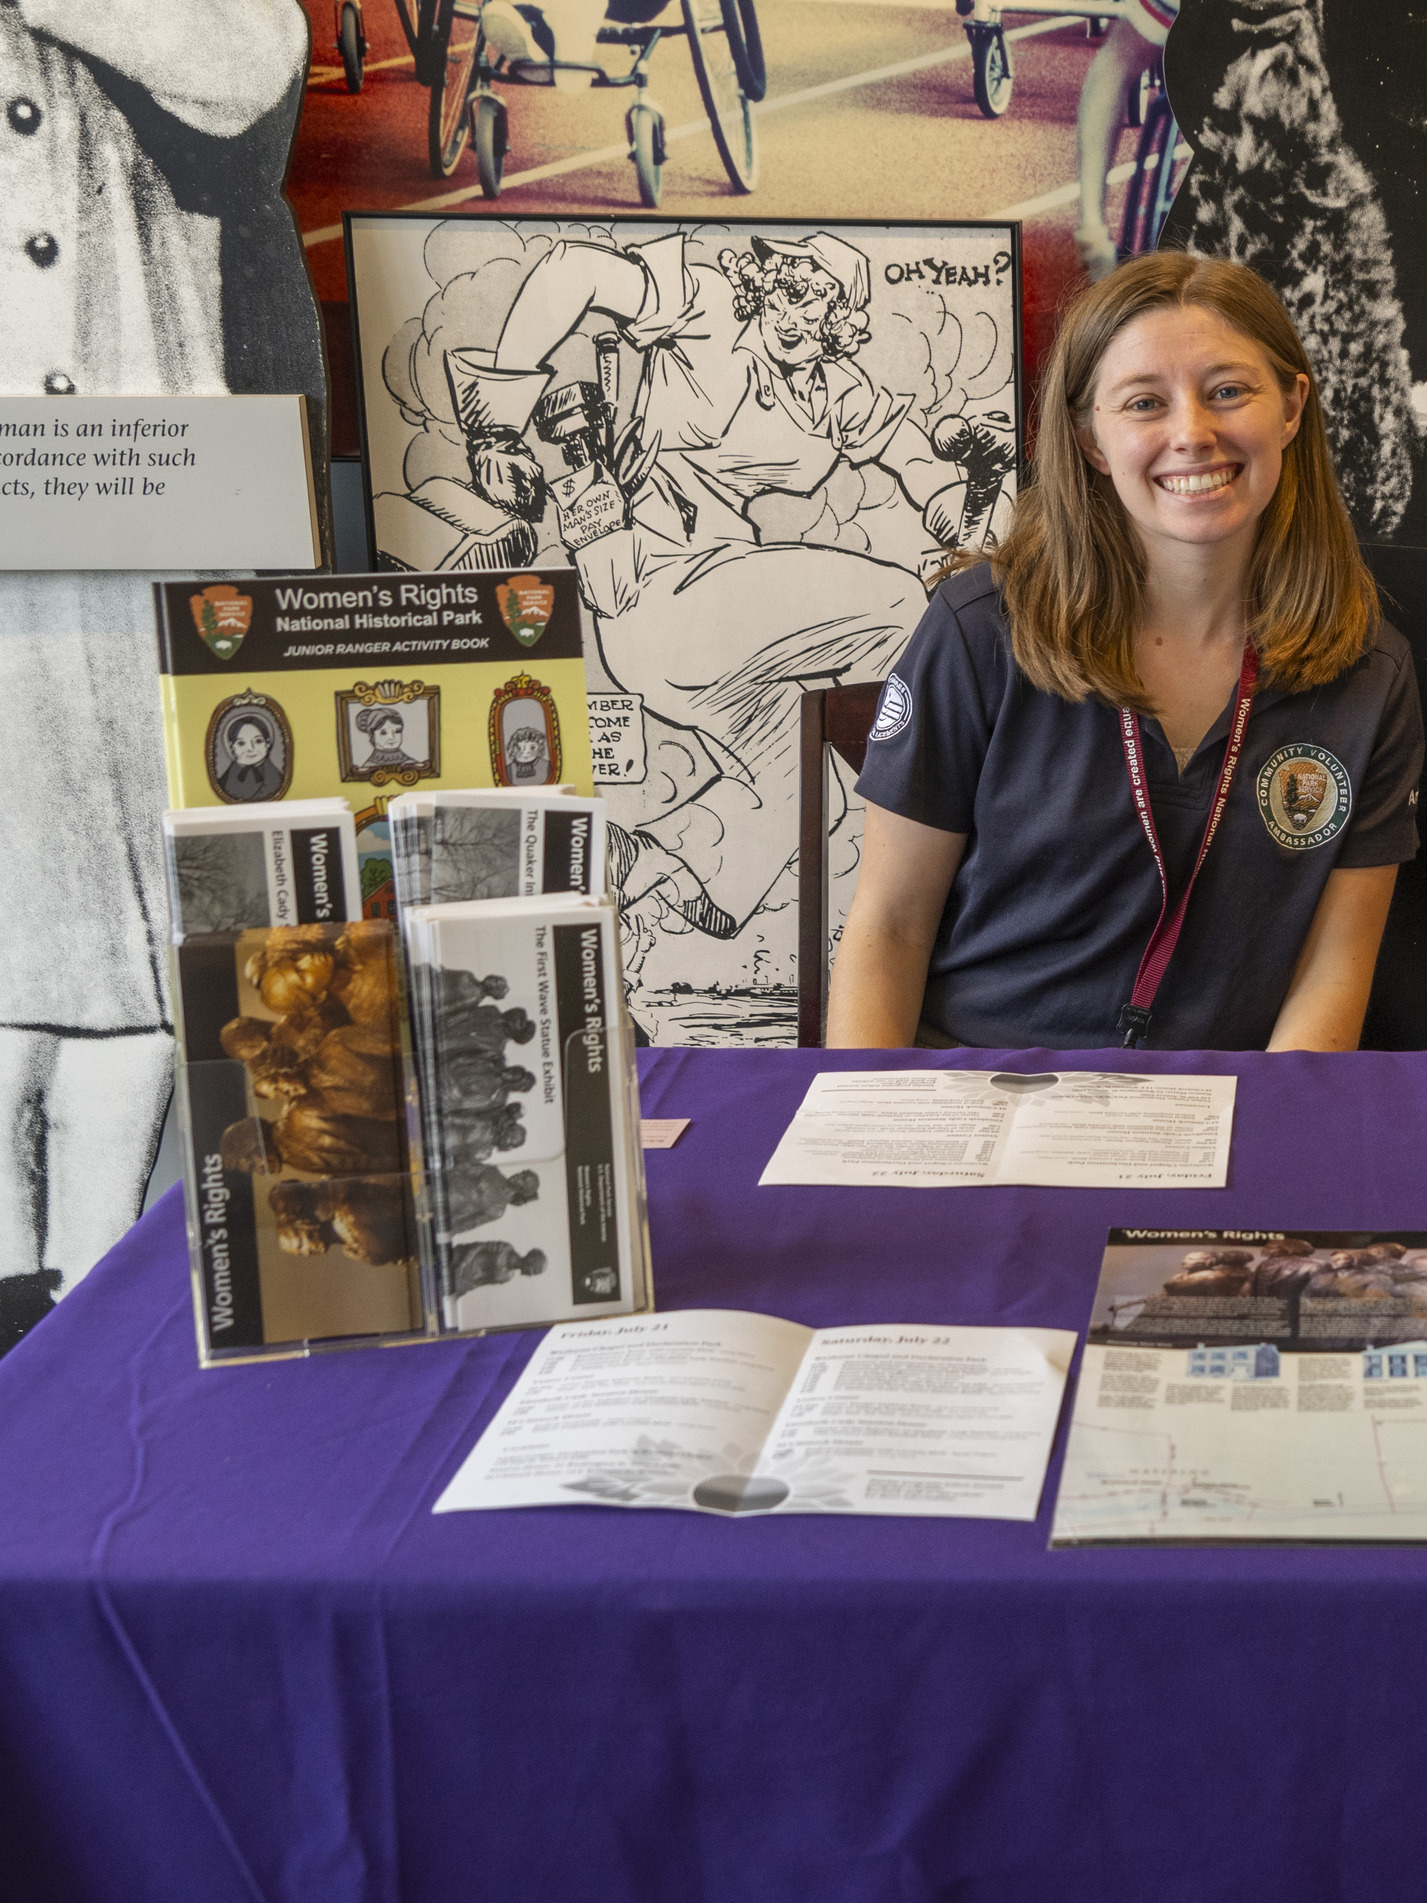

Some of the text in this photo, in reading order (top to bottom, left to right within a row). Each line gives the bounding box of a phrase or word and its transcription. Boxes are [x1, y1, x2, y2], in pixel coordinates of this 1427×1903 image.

[885, 260, 926, 285] OH
[53, 418, 69, 437] is
[76, 422, 104, 437] an
[111, 418, 189, 442] inferior
[93, 448, 141, 466] with
[148, 448, 196, 466] such
[0, 477, 166, 501] cts, they will be
[563, 490, 610, 522] HER OWN
[594, 500, 616, 516] SIZE
[573, 519, 622, 546] ENVELOPE
[580, 519, 602, 534] PAY
[275, 583, 479, 611] Women's Rights
[276, 610, 483, 632] National Historical Park
[283, 637, 491, 657] JUNIOR RANGER ACTIVITY BOOK
[598, 732, 622, 743] AS
[1125, 739, 1141, 786] created
[1206, 698, 1251, 847] Women's Rights National
[1260, 747, 1348, 812] COMMUNITY VOLUNTEER
[1298, 773, 1326, 781] NATIONAL
[1135, 789, 1146, 808] are
[525, 810, 539, 879] The Quaker
[1140, 811, 1158, 853] women
[1269, 820, 1337, 845] AMBASSADOR
[569, 817, 589, 892] Women'
[271, 830, 291, 921] Elizabeth Cady
[309, 833, 334, 919] Women's
[536, 925, 556, 1104] The First Wave Statue Exhibit
[581, 929, 605, 1074] Women's Rights
[201, 1153, 235, 1332] Women's Rights
[1125, 1229, 1286, 1242] Women's Rights
